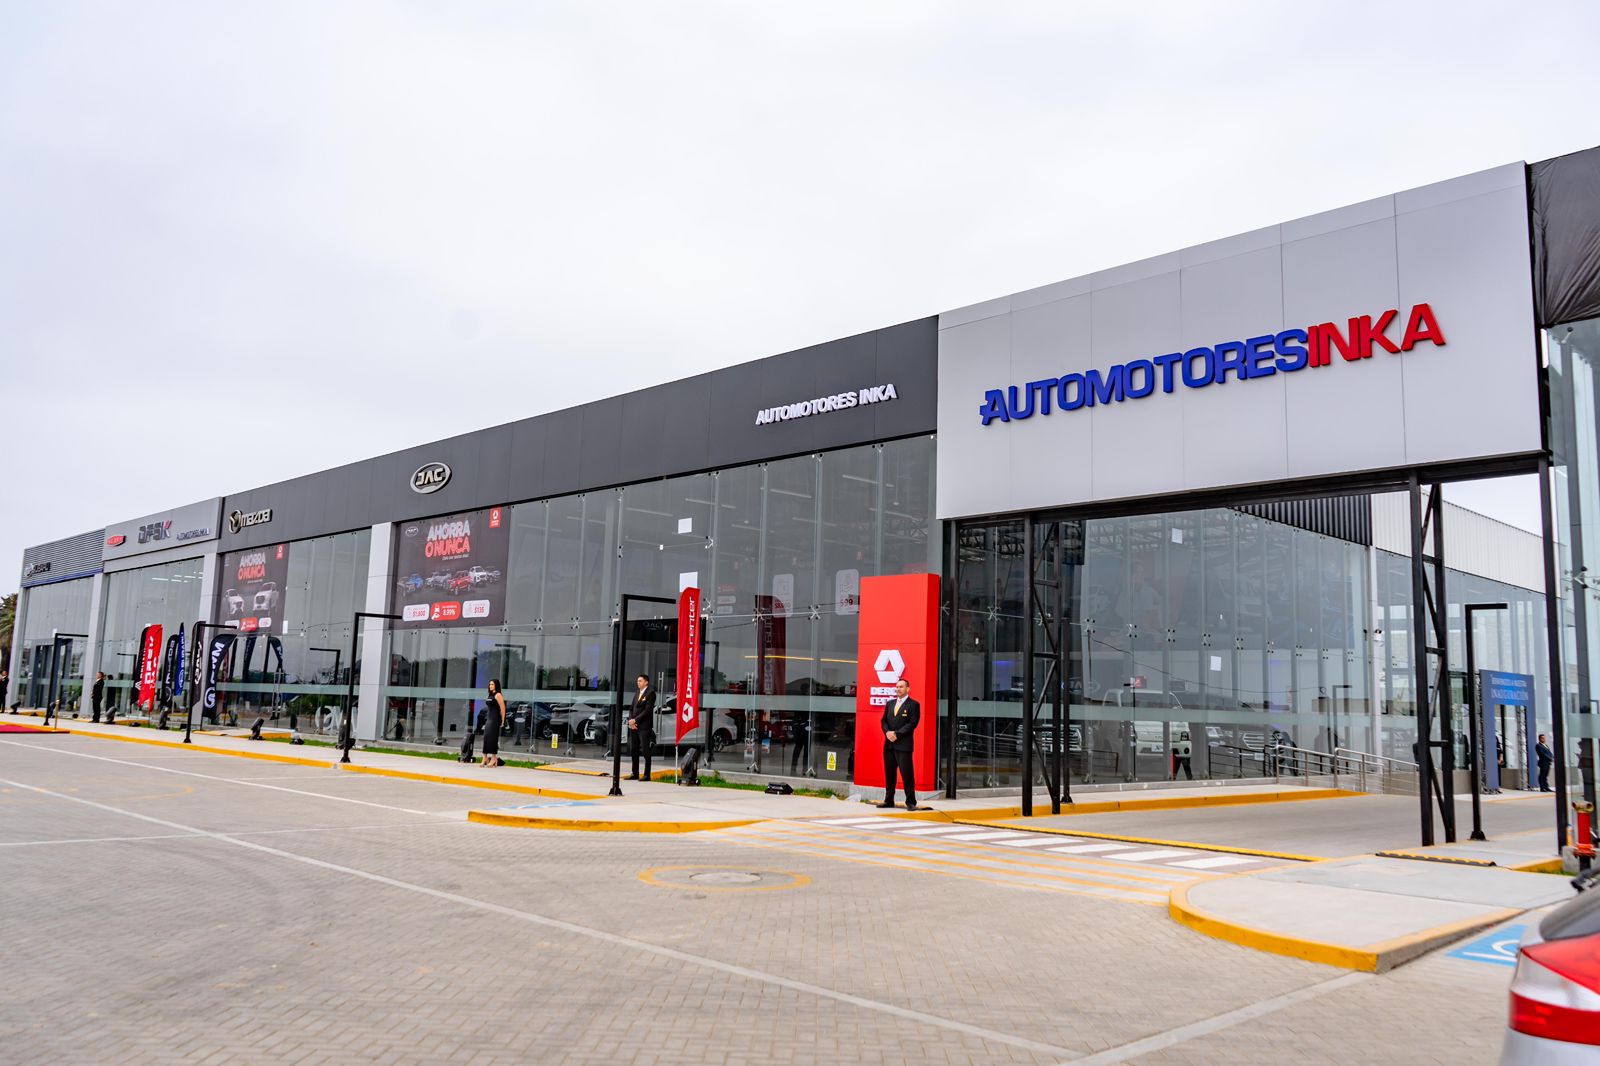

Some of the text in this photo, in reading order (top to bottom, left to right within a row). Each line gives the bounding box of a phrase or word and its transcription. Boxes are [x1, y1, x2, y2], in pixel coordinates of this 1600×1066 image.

[755, 383, 898, 425] AUTOMOTORES INKA
[415, 467, 443, 485] JAC
[138, 519, 172, 544] DFSK
[427, 519, 471, 542] AHORRA
[425, 541, 434, 558] O
[433, 536, 470, 557] NUNCA
[870, 686, 897, 696] DERC
